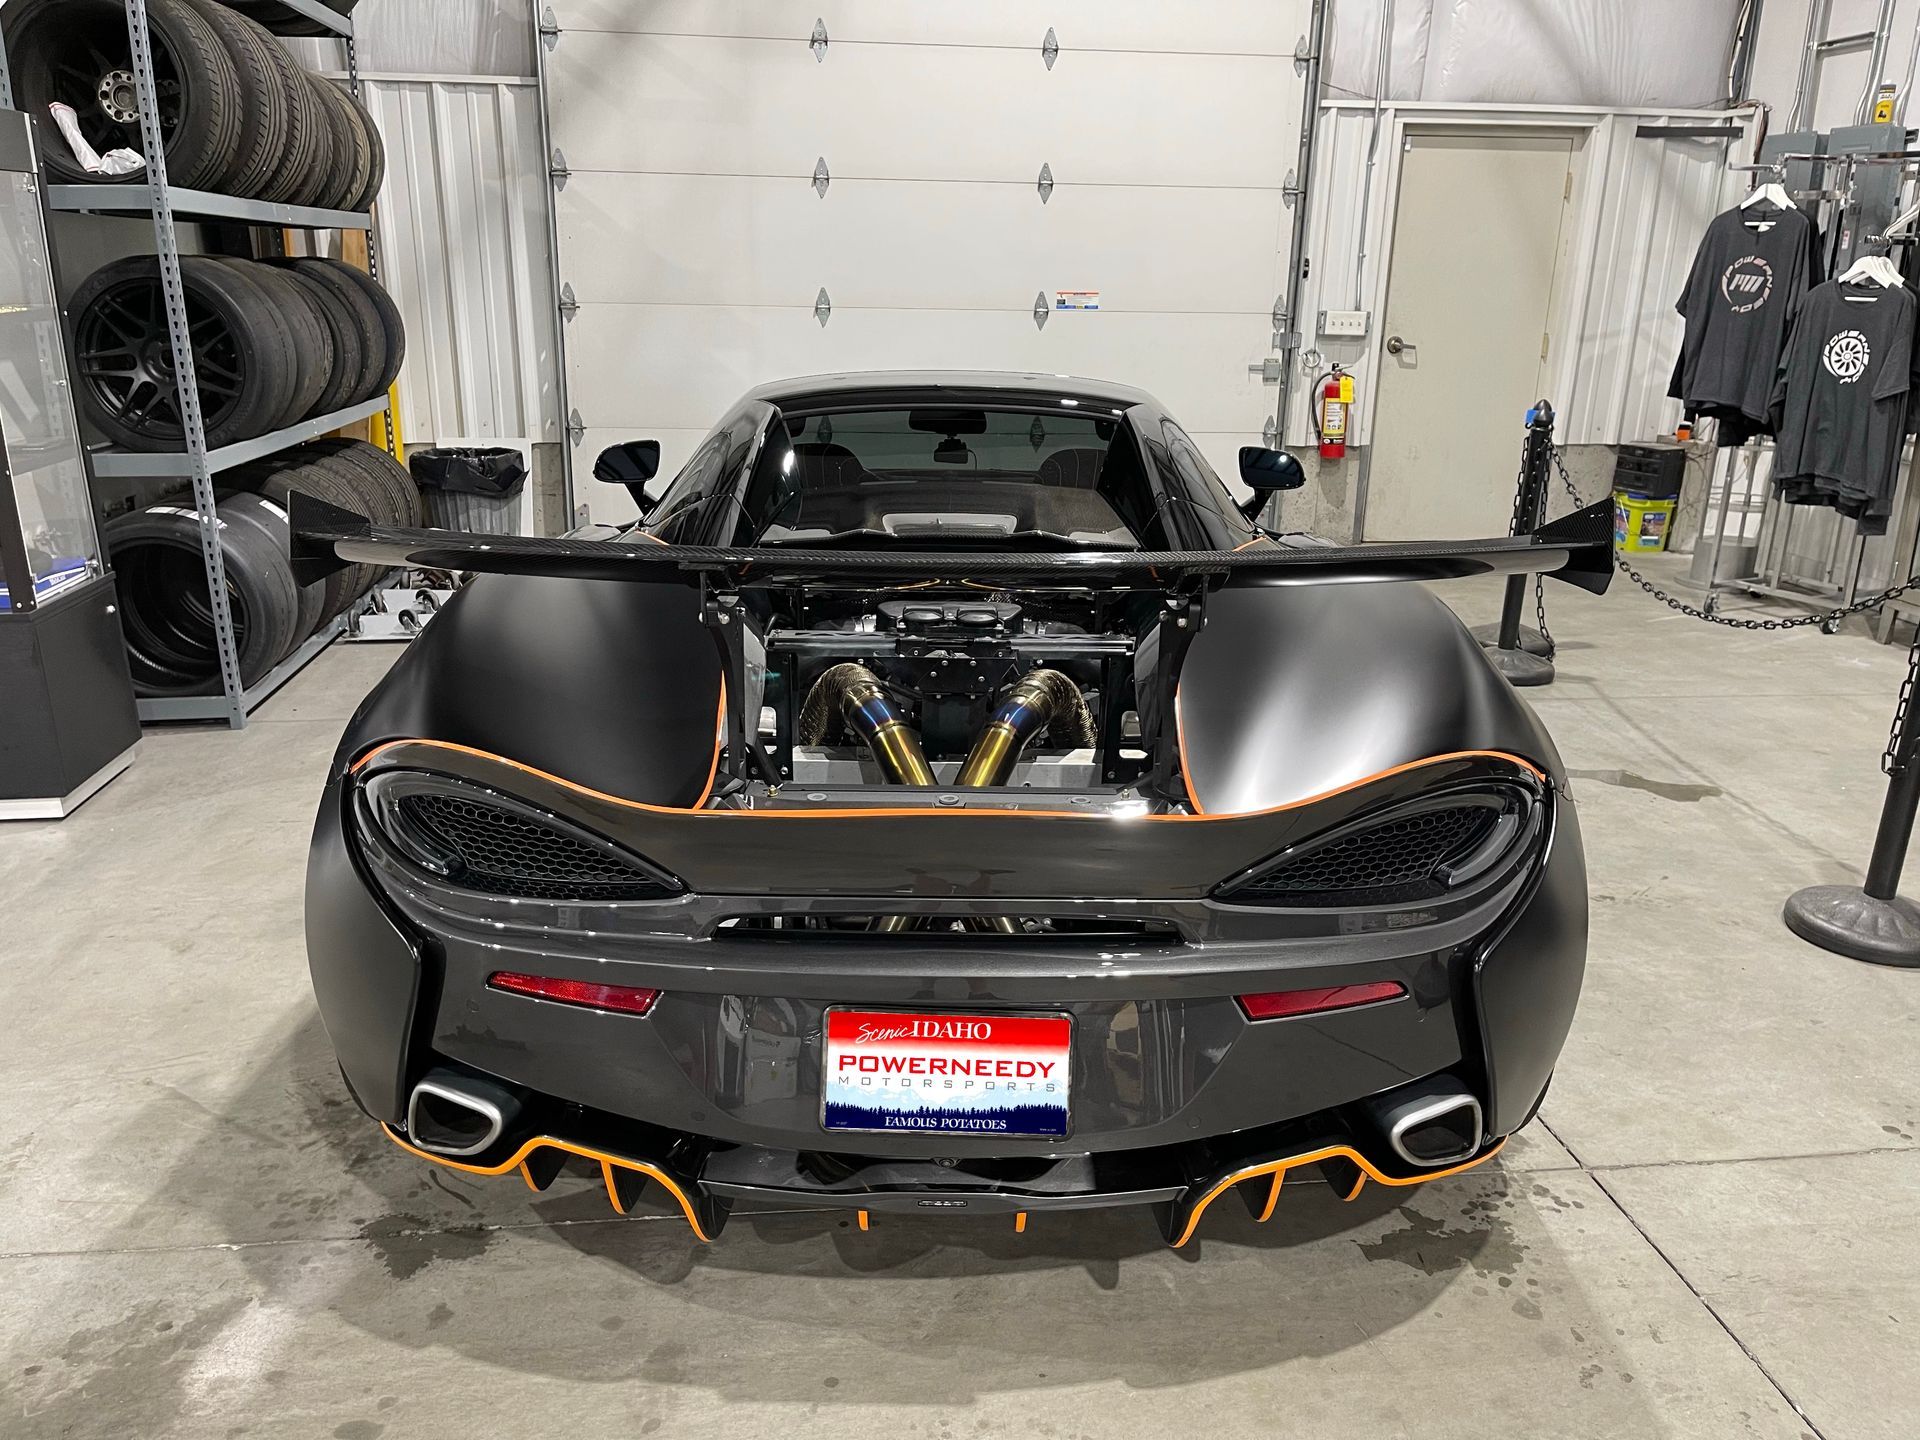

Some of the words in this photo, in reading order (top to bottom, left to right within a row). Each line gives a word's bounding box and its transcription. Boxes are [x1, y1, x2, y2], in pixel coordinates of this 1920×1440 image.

[856, 1022, 913, 1044] Scenic
[912, 1020, 992, 1040] IDAHO
[838, 1055, 1055, 1078] POWERNEEDY
[838, 1076, 1055, 1092] MOTORSPORTS
[885, 1116, 937, 1128] FAMOUS
[940, 1119, 1007, 1130] POTATOES
